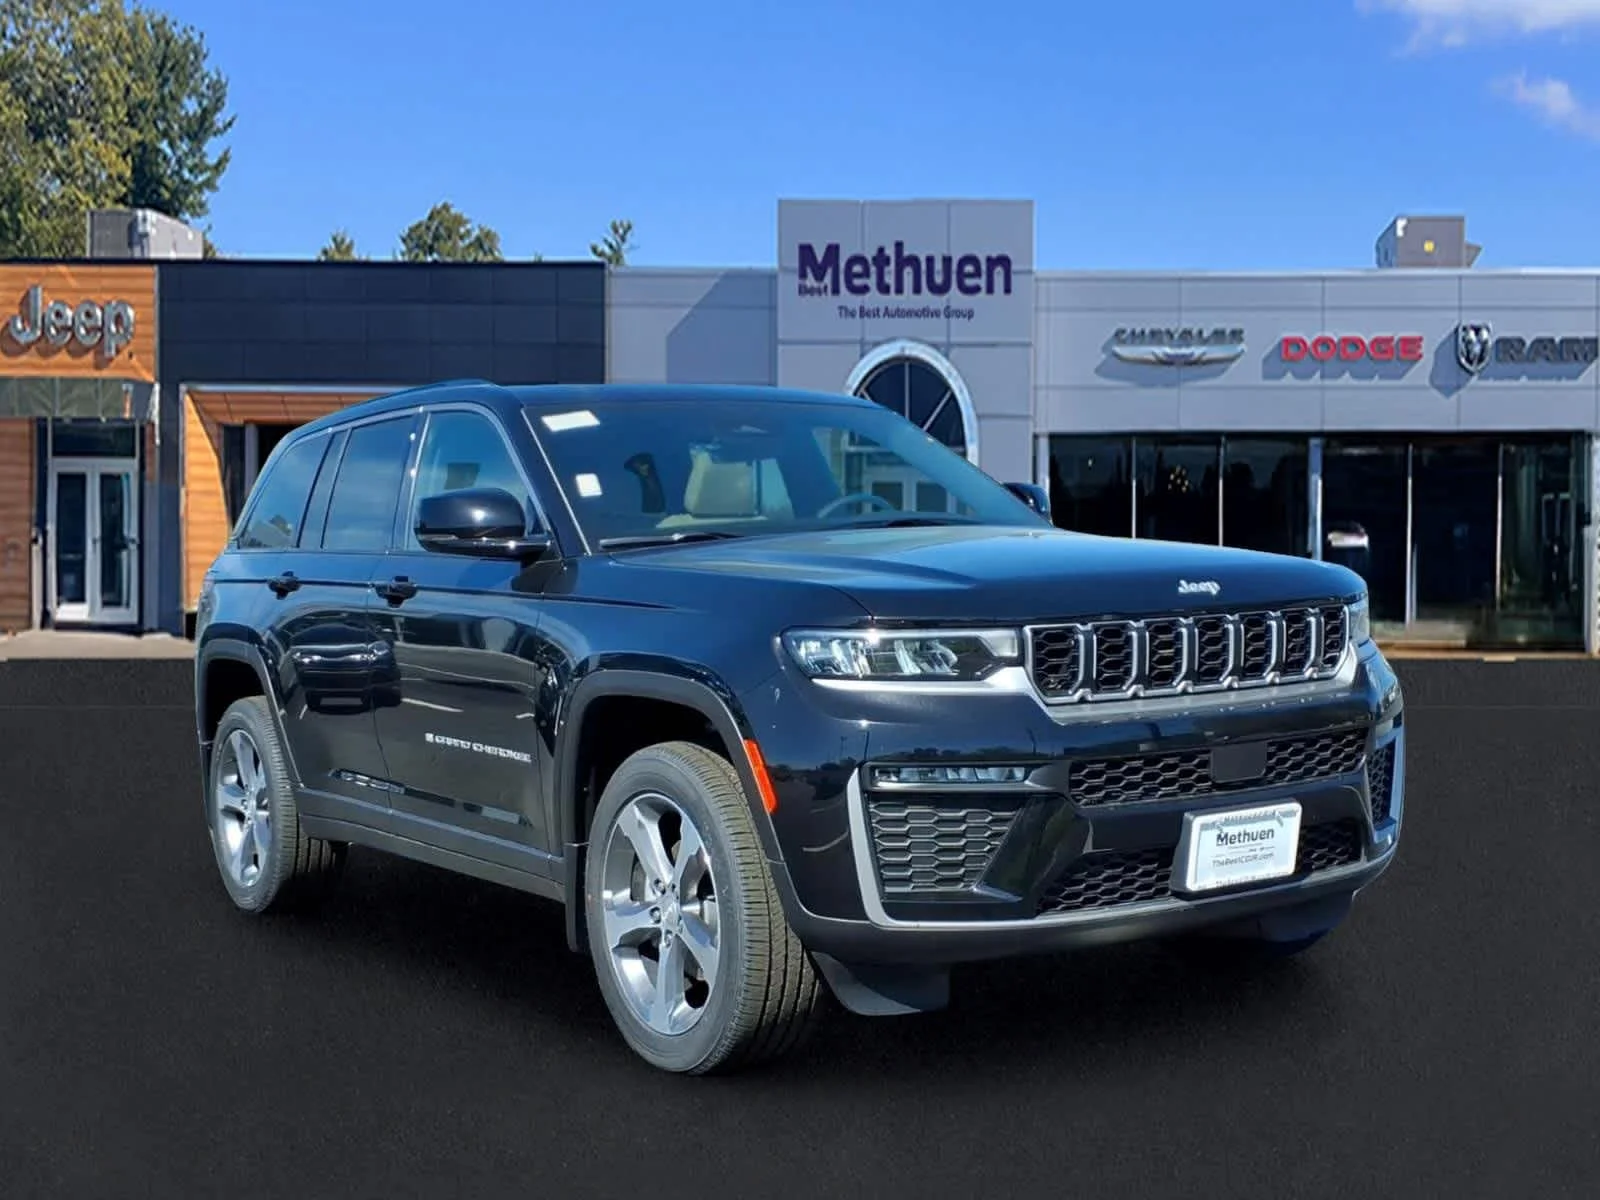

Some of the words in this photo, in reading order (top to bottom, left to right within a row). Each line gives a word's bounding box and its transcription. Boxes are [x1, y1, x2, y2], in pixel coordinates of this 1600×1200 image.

[798, 241, 1012, 296] Methuen
[798, 283, 828, 297] Best
[9, 285, 135, 357] Jeep
[837, 305, 857, 318] The
[859, 305, 880, 318] Best
[883, 305, 941, 319] Automotive
[943, 305, 975, 321] Group
[1281, 335, 1424, 362] DODGE
[1495, 336, 1598, 363] RAM
[1216, 828, 1275, 847] Methuen
